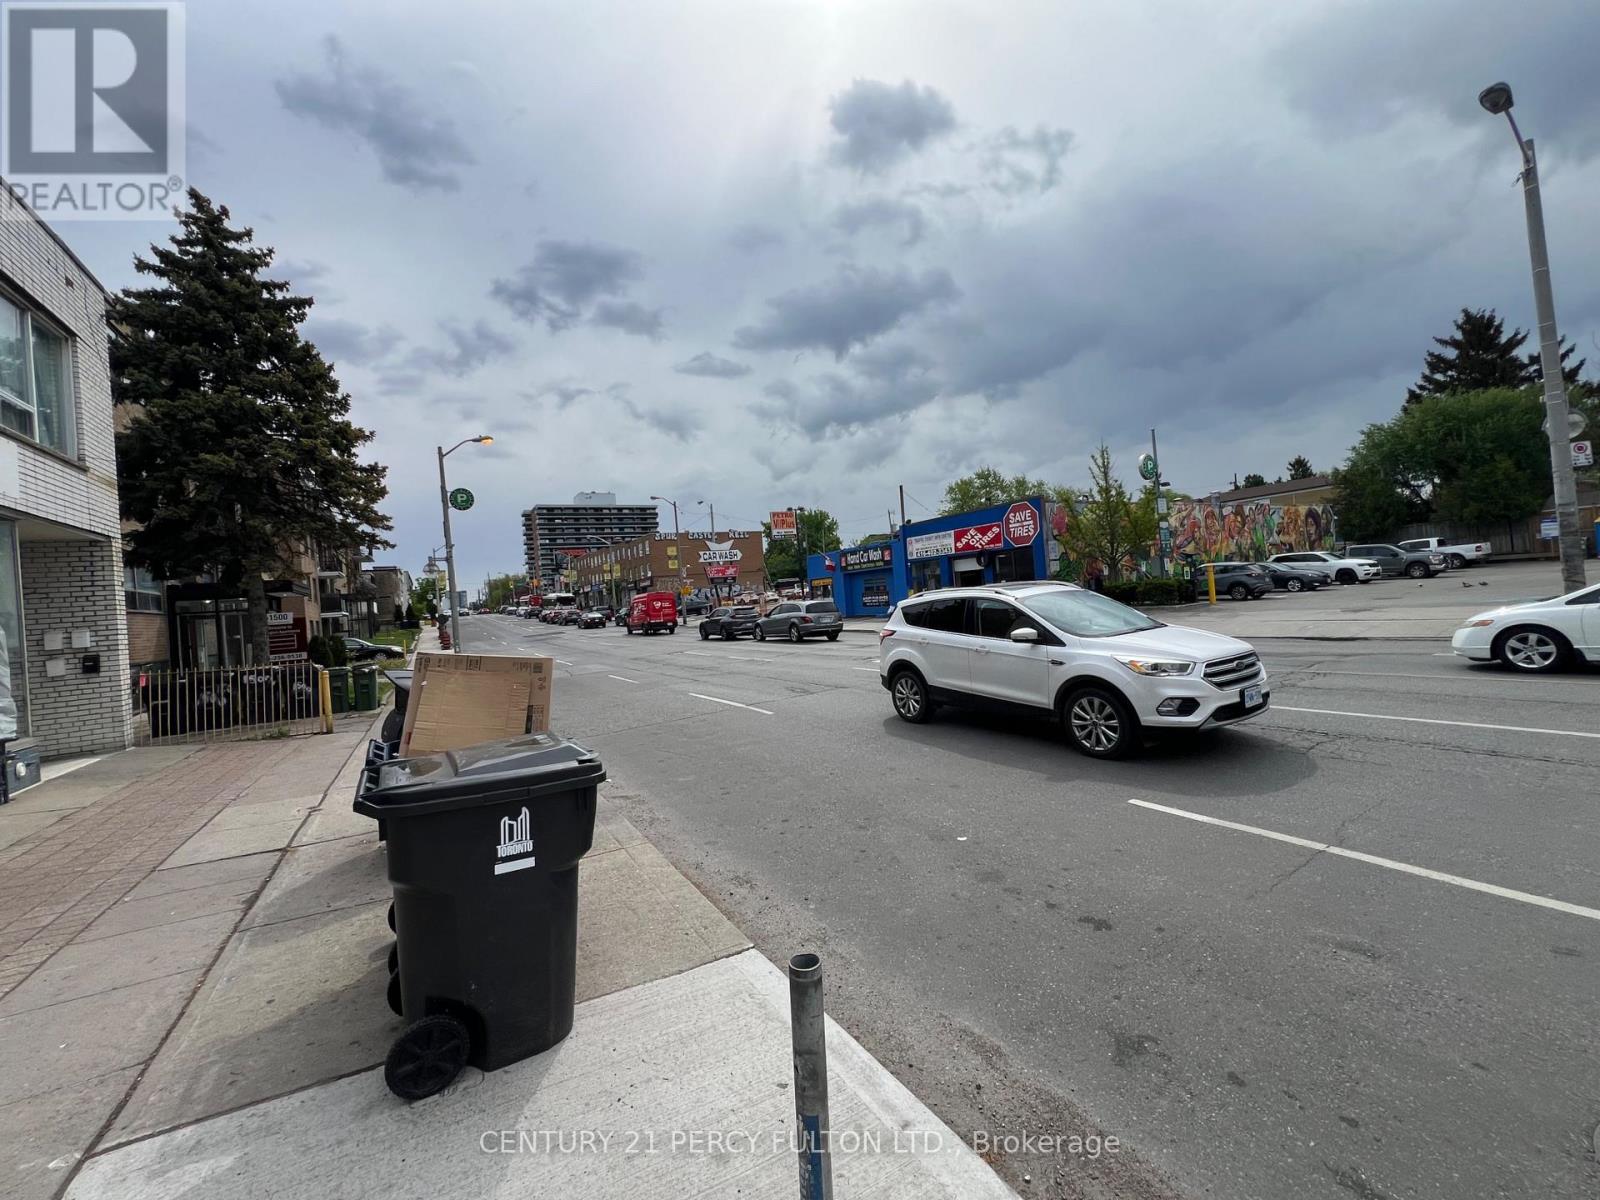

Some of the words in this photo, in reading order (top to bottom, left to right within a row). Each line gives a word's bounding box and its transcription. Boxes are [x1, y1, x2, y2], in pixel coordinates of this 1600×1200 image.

[1009, 510, 1032, 524] SAVE
[956, 528, 977, 549] SAVE
[969, 532, 983, 545] ON
[974, 526, 1000, 549] TIRES
[1009, 524, 1035, 538] TIRES
[703, 553, 718, 561] CAR
[719, 552, 738, 560] WASH
[847, 551, 860, 564] Hand
[860, 550, 869, 562] Car
[869, 547, 882, 561] Wash
[496, 840, 534, 857] TORONTO
